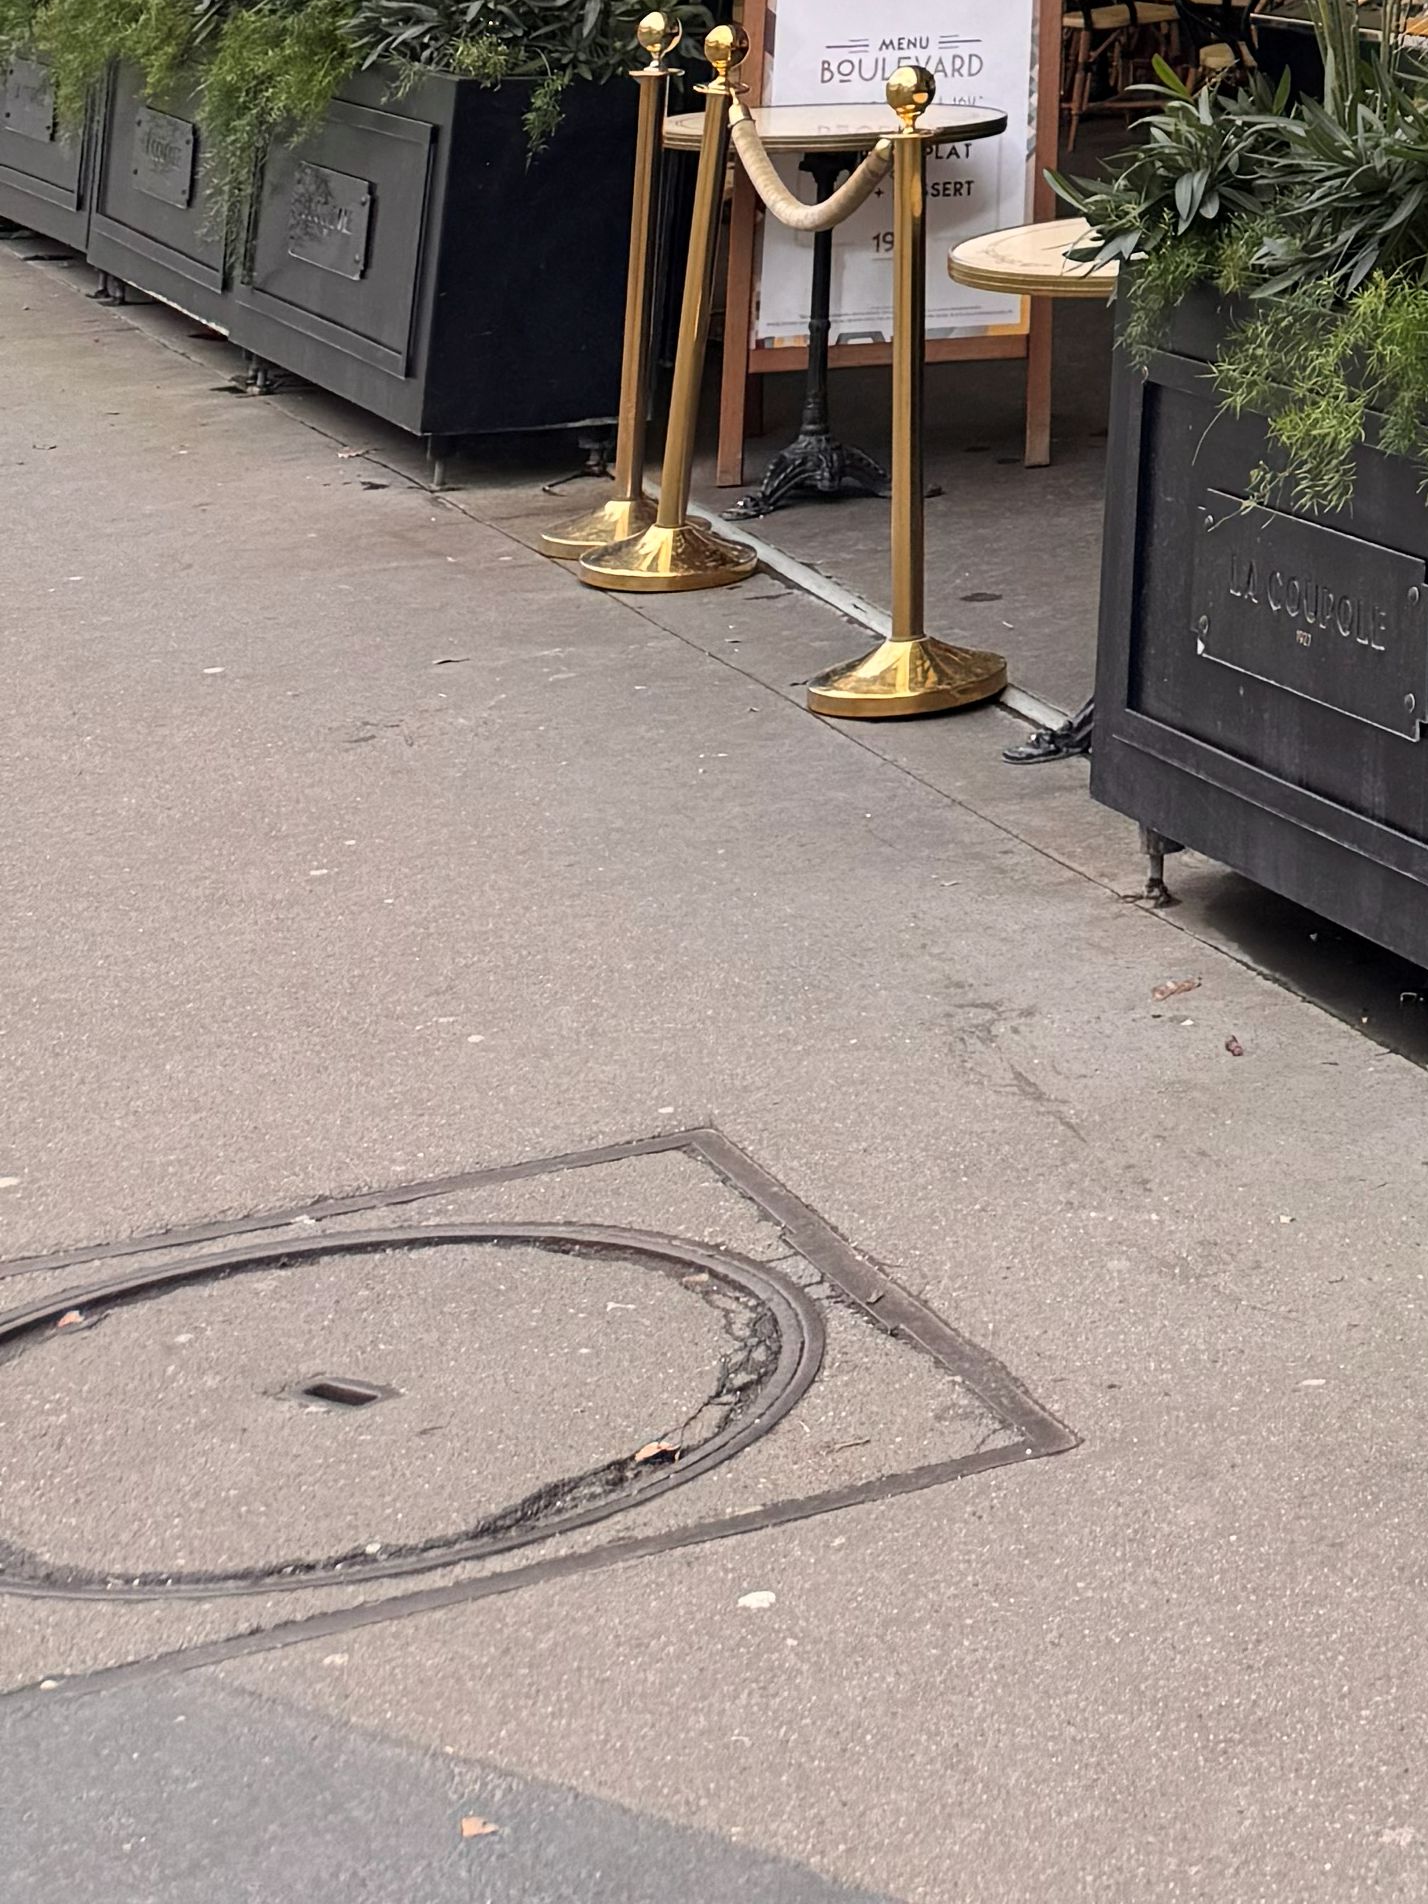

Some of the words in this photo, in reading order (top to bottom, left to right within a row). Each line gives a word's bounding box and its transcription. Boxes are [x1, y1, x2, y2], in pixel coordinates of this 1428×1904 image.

[878, 36, 930, 52] MENU
[820, 53, 984, 84] BOULARD
[1229, 553, 1259, 604] LA
[1266, 571, 1386, 651] COUPOLE
